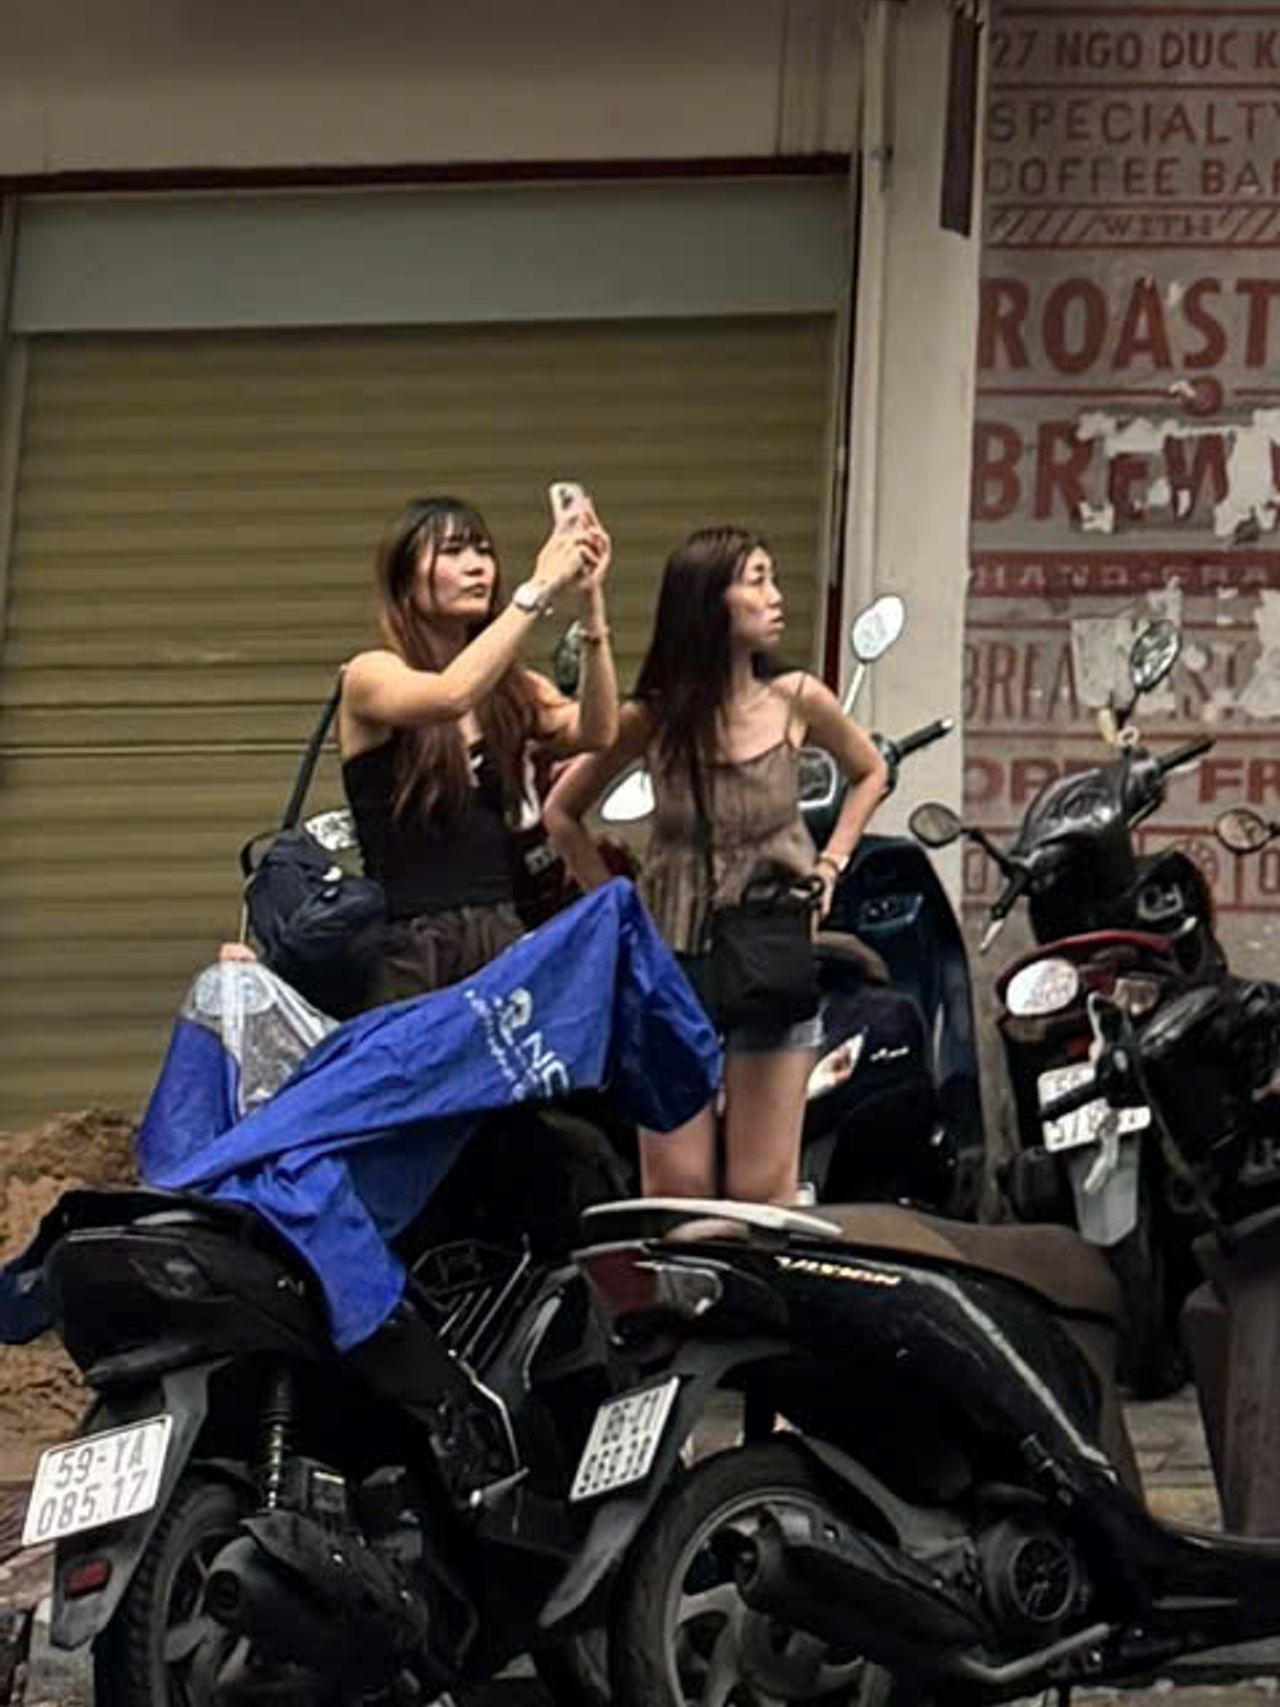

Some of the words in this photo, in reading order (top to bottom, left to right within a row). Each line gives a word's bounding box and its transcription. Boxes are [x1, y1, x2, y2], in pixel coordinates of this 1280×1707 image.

[989, 31, 1035, 69] 27
[1056, 30, 1142, 70] NGO
[1160, 30, 1241, 70] DUC
[984, 157, 1180, 196] COFFEE
[1104, 212, 1214, 237] WITH
